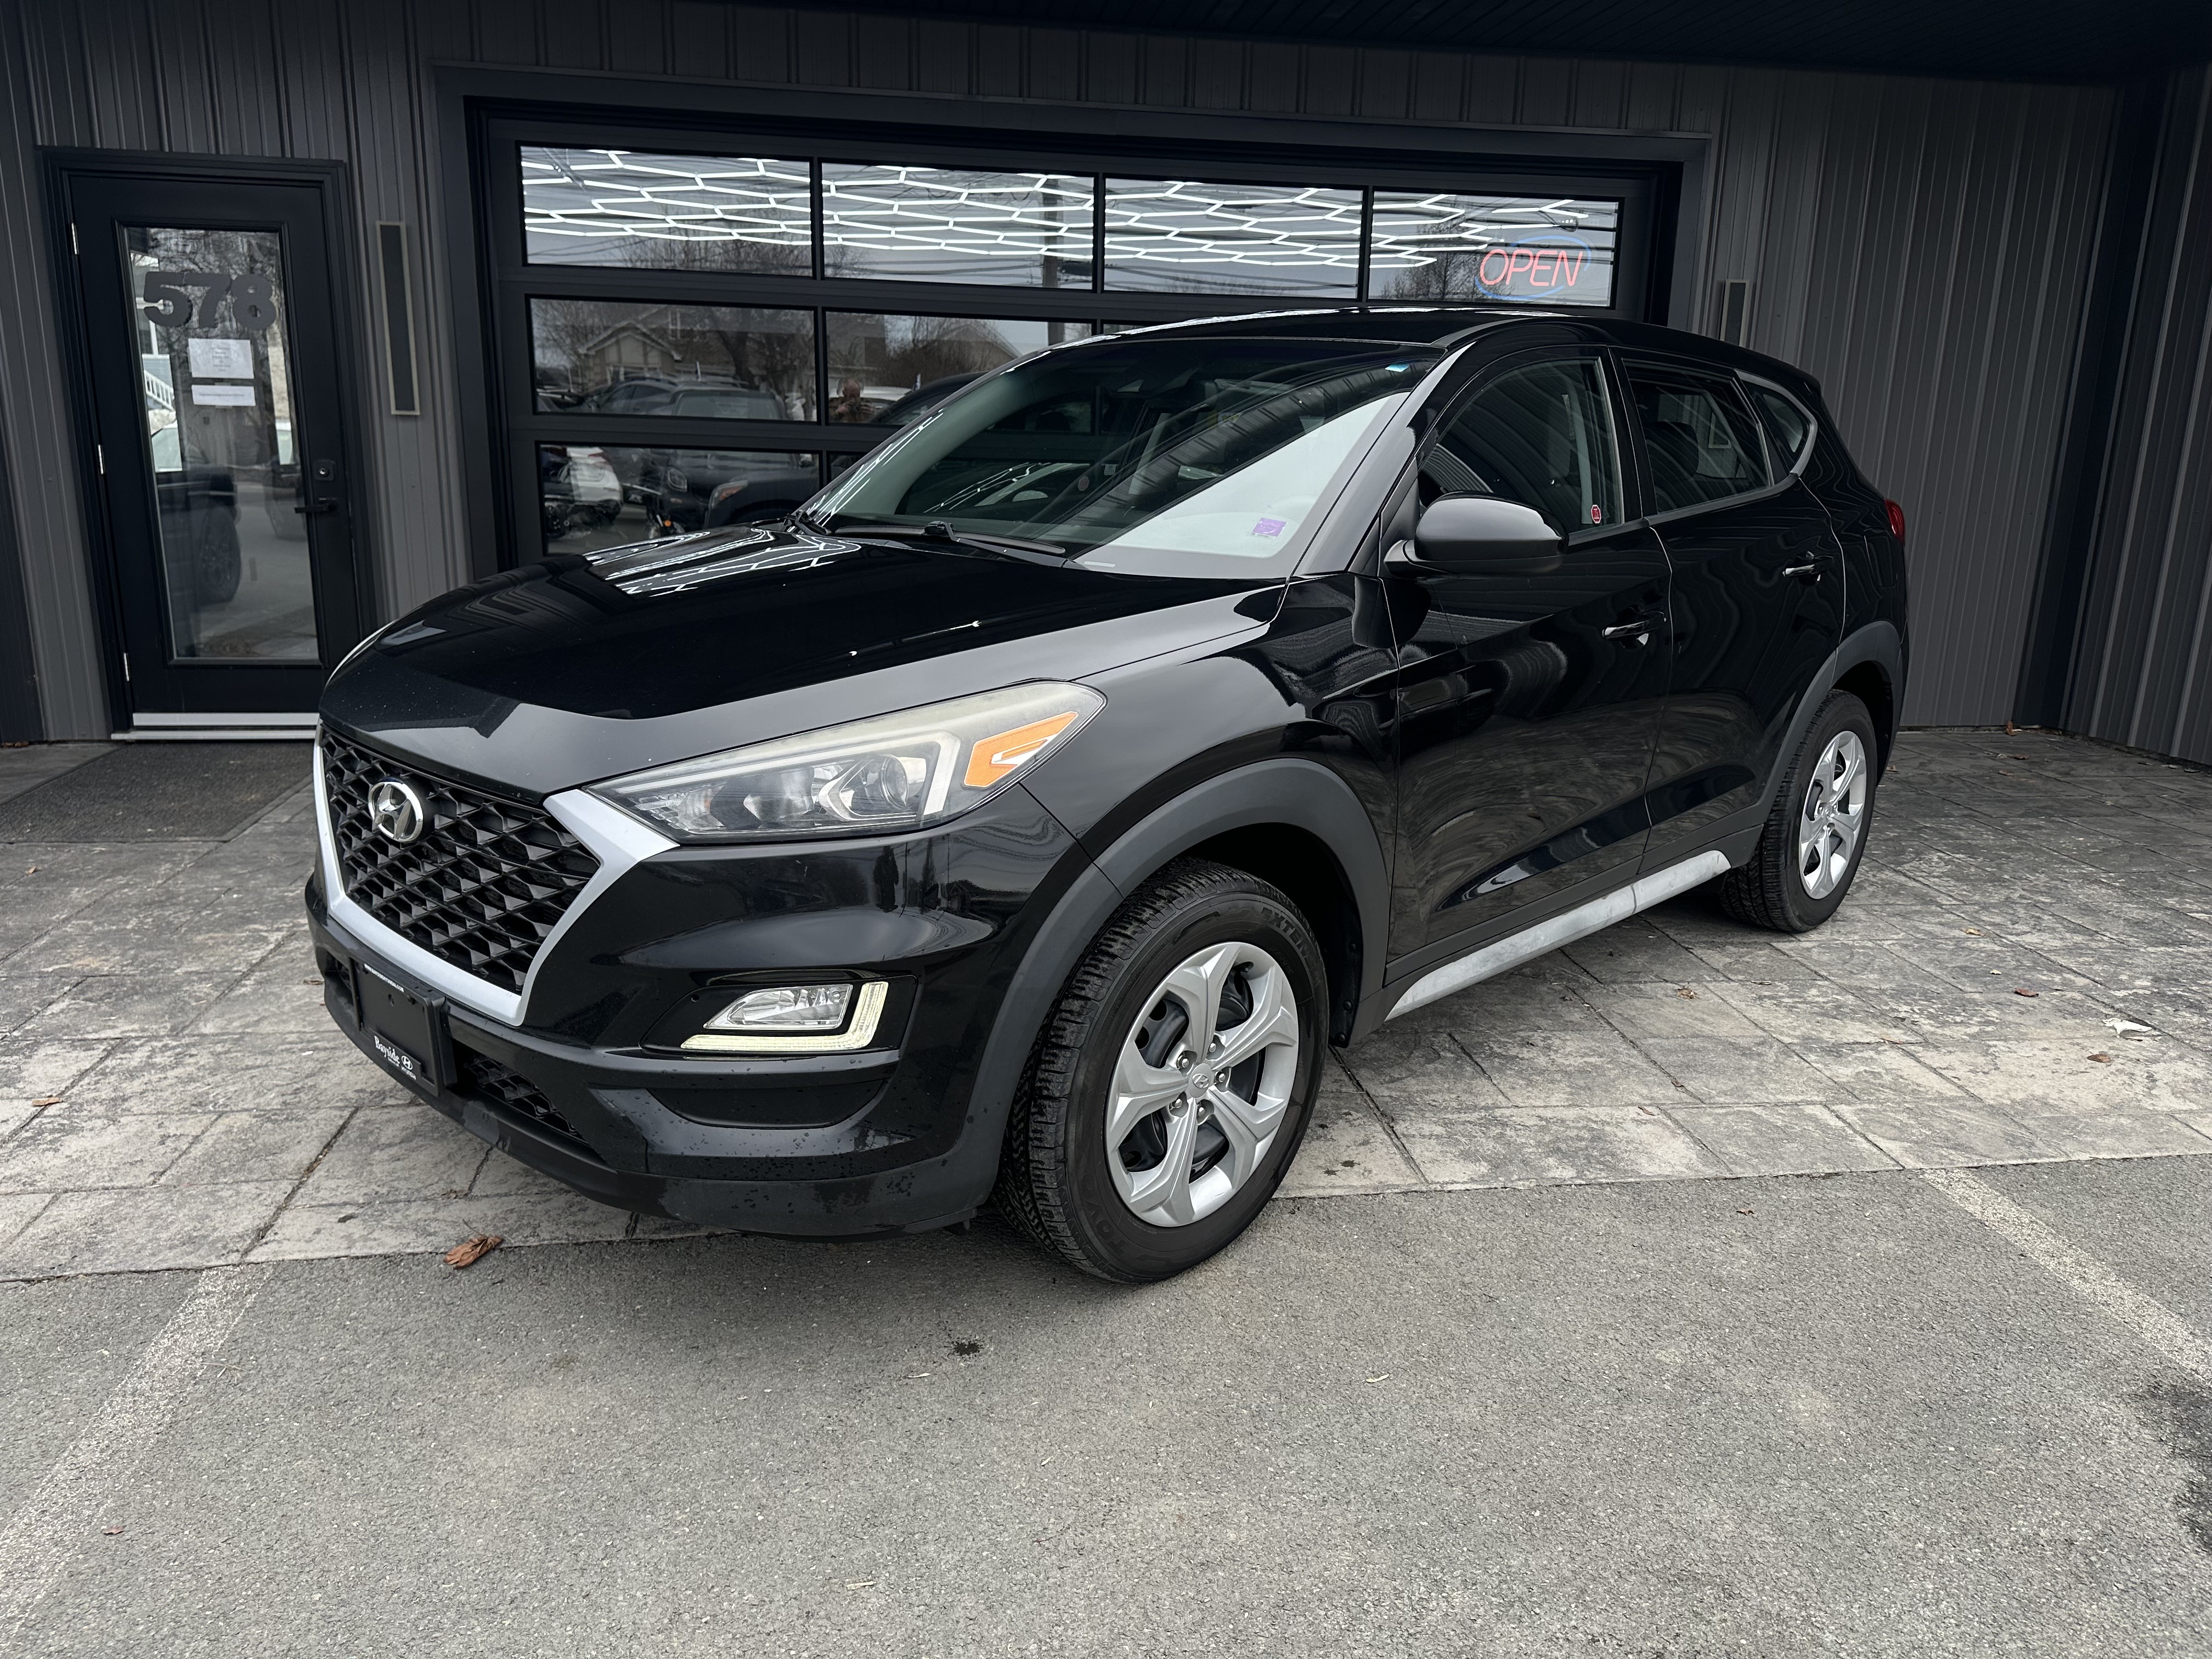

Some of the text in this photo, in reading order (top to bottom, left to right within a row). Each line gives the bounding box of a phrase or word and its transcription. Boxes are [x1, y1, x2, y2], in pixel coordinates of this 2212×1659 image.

[1480, 249, 1582, 286] OPEN
[143, 272, 276, 330] 578
[374, 1035, 400, 1064] Bayside
[1082, 1174, 1129, 1255] TOYO
